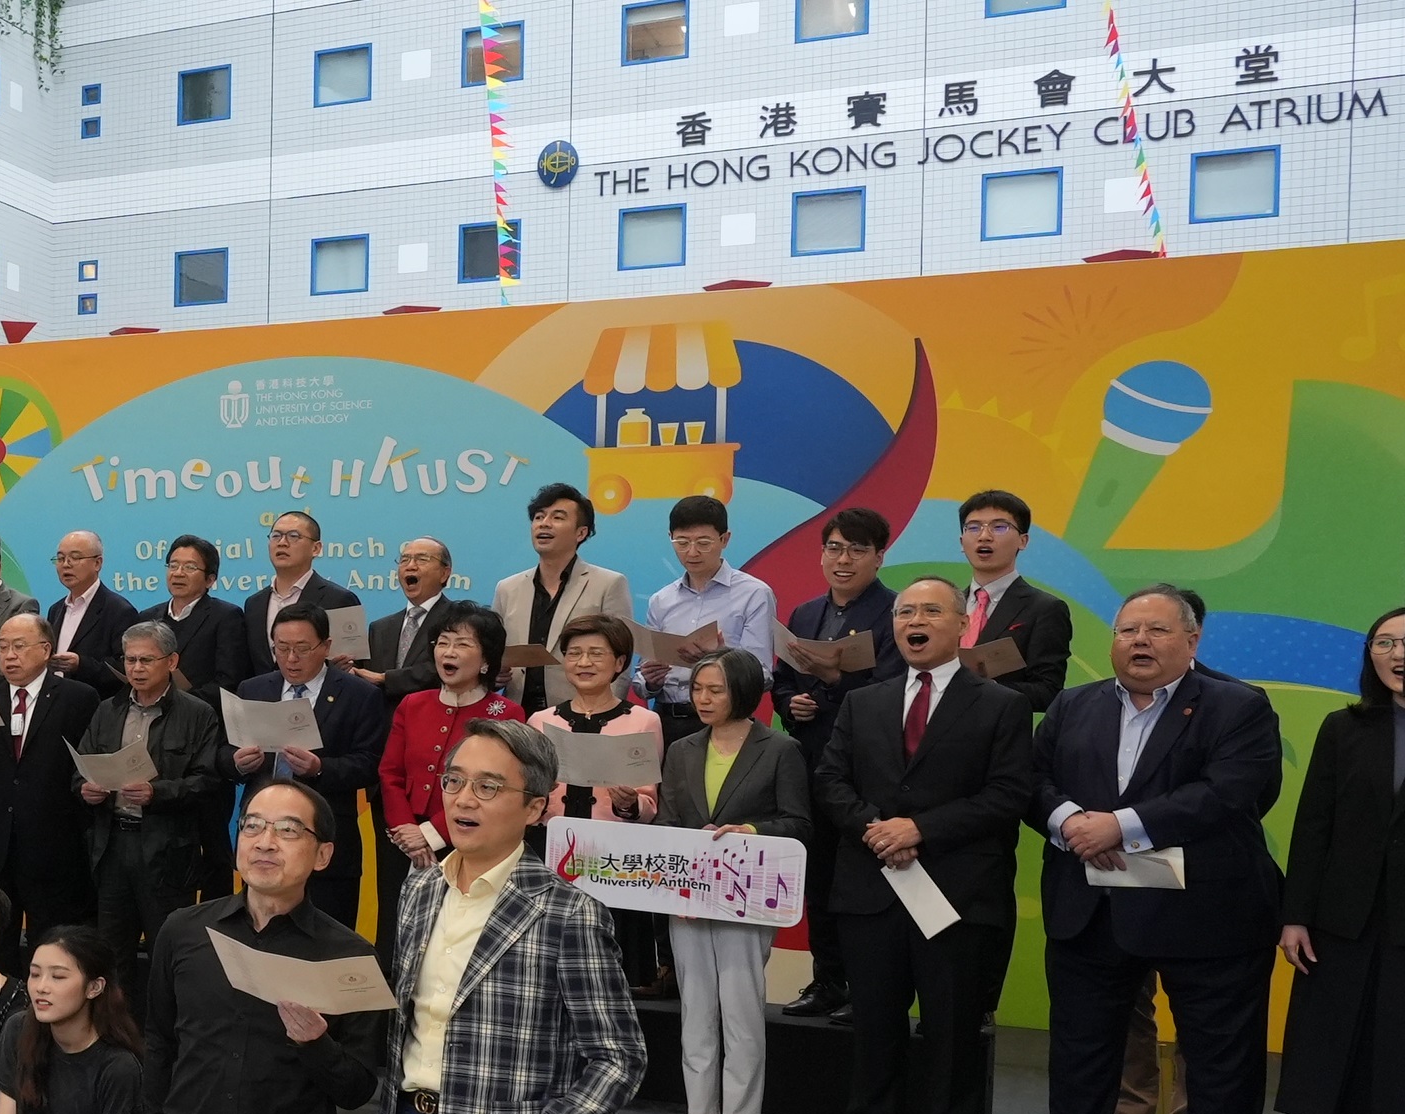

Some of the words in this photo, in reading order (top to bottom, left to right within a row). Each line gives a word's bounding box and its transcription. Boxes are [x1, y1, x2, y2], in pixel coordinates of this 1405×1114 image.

[675, 45, 1281, 148] 香港賽馬會大堂
[594, 169, 649, 197] THE
[666, 155, 771, 190] HONG
[789, 141, 897, 179] KONG
[917, 121, 1071, 167] JOCKEY
[1093, 109, 1197, 147] CLUB
[1219, 88, 1389, 135] ATRIUM
[255, 375, 335, 391] 香港科技大學
[255, 393, 272, 402] THE
[276, 391, 308, 400] HONG
[311, 388, 343, 399] KONG
[255, 403, 310, 414] UNIVERSITY
[312, 402, 327, 411] OF
[330, 400, 373, 410] SCIENCE
[255, 417, 278, 426] AND
[281, 413, 349, 425] TECHNOLOGY
[71, 454, 313, 504] Timeout
[113, 571, 159, 591] the
[600, 853, 690, 876] 大學校歌
[590, 873, 655, 890] University
[658, 876, 711, 892] Anthem
